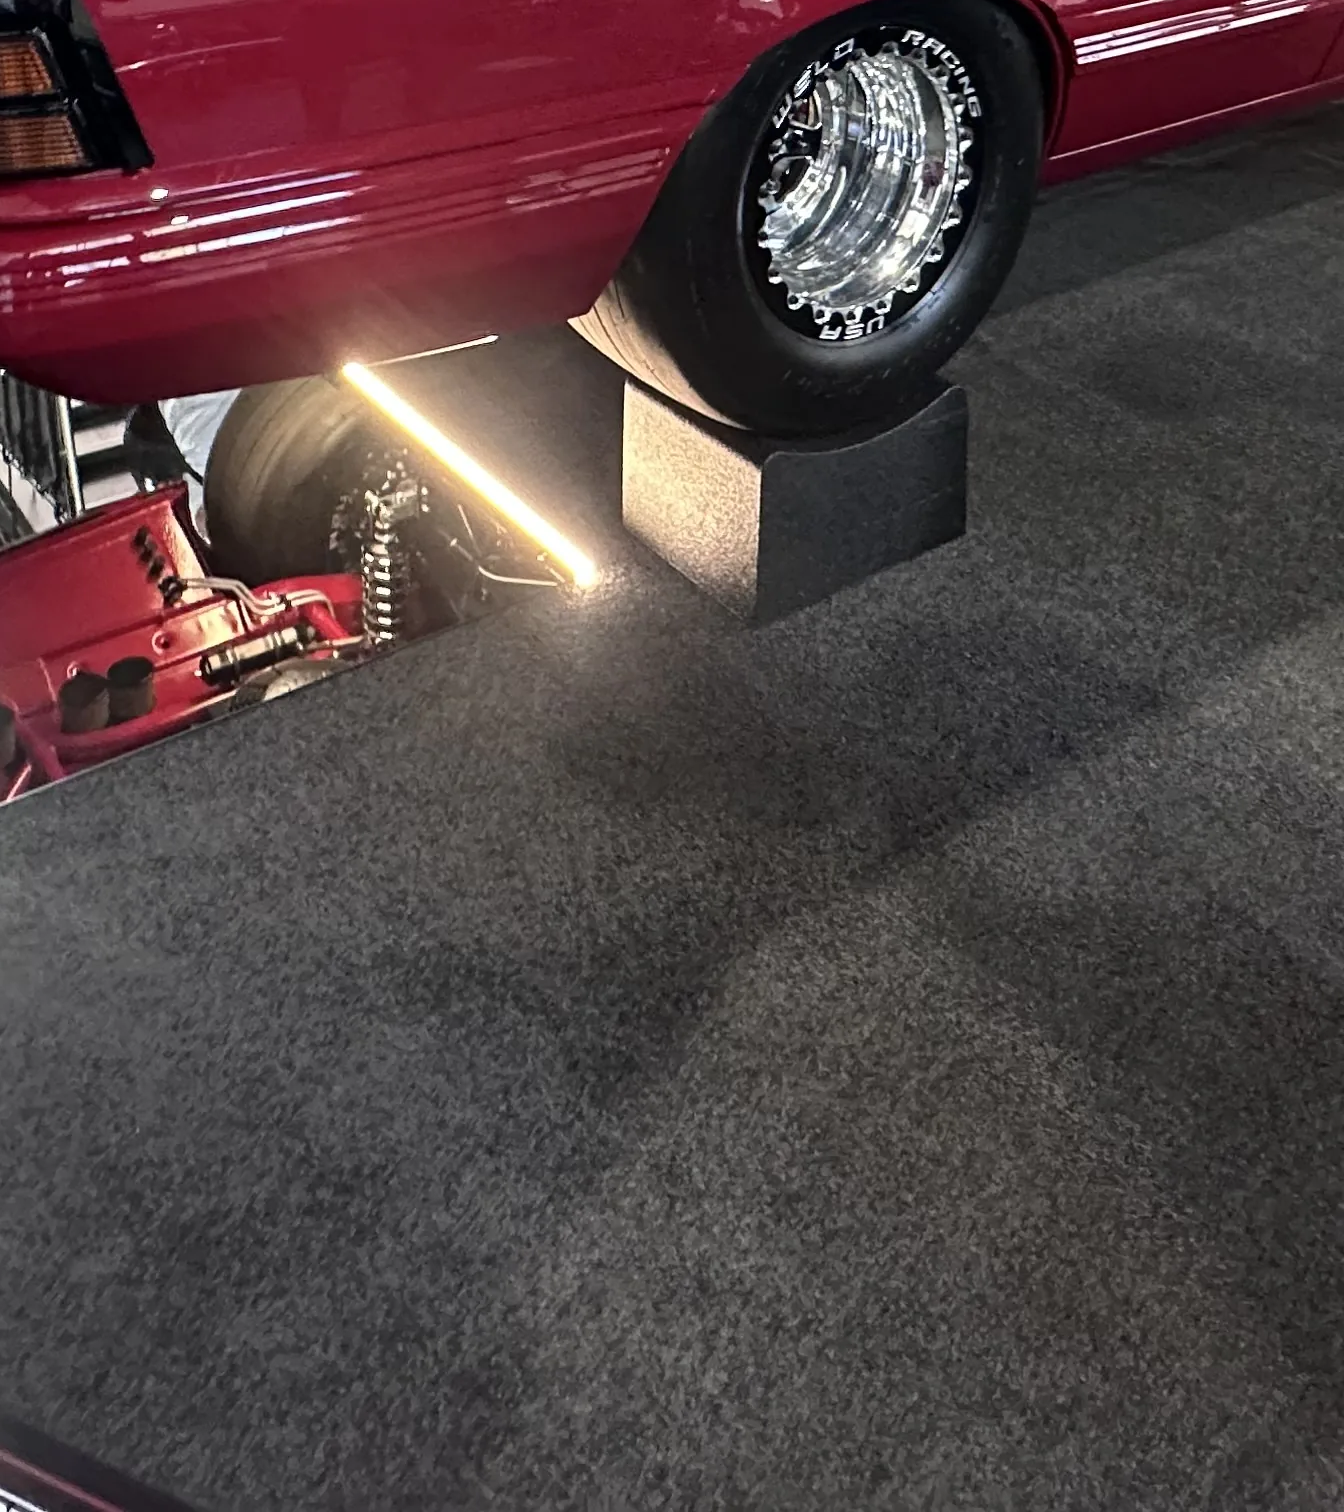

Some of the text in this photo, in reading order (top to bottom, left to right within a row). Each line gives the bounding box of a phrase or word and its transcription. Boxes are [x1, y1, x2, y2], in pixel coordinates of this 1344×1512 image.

[771, 29, 983, 129] WELD RACING
[818, 315, 885, 341] USA
